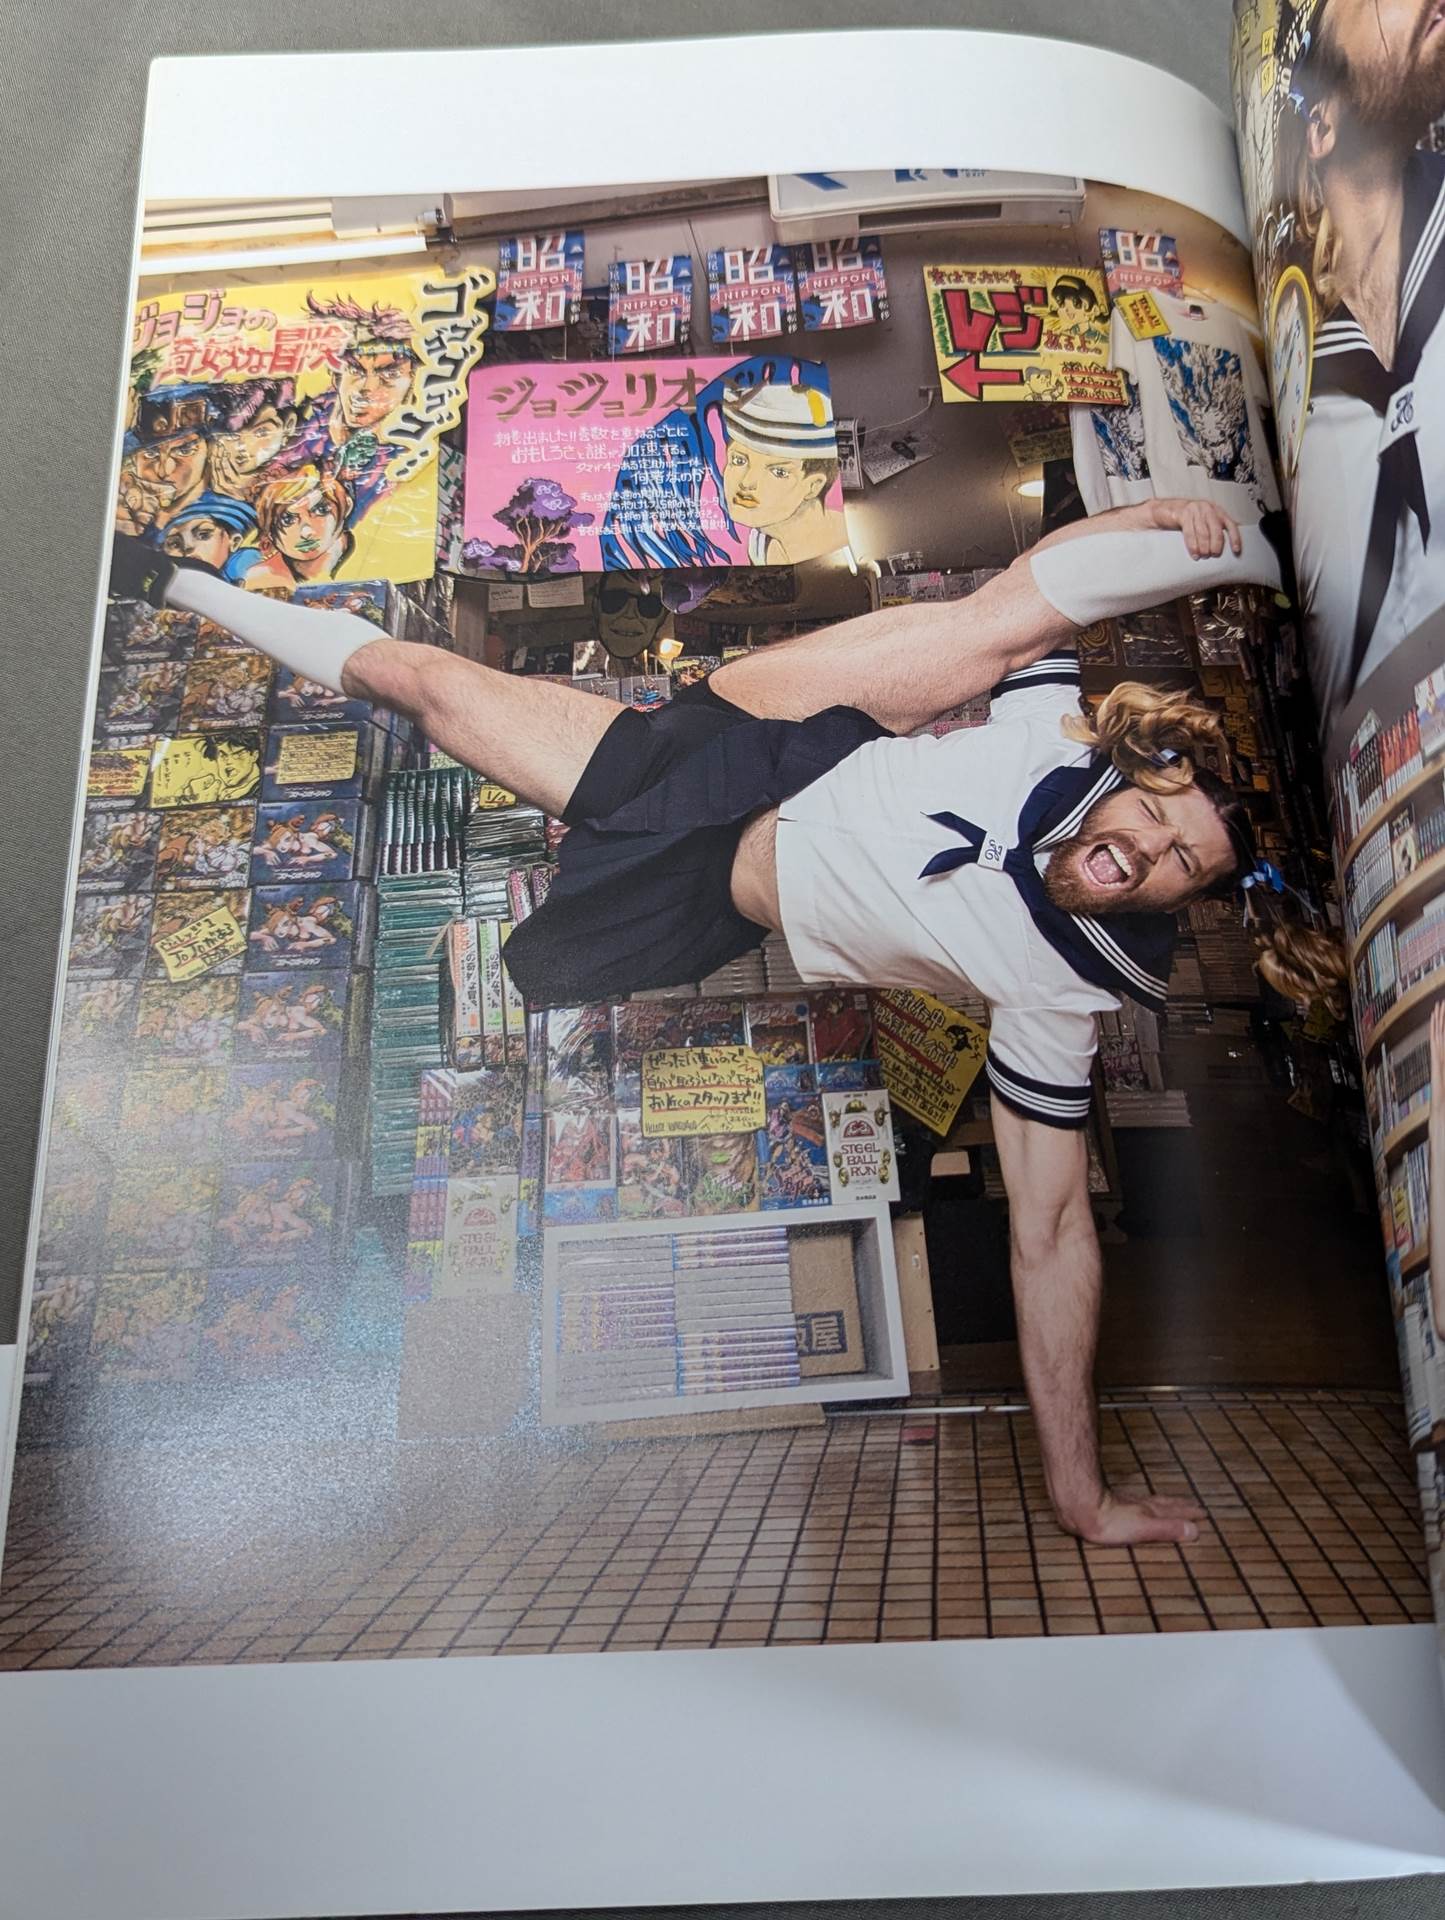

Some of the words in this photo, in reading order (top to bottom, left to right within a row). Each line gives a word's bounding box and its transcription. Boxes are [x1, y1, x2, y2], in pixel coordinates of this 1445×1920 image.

[512, 274, 570, 289] NIPPON
[812, 273, 872, 288] NIPPON
[723, 286, 781, 300] NIPPON
[623, 297, 679, 312] NIPPON
[941, 286, 1048, 352] レジ
[155, 324, 343, 380] 奇妙な冒険
[841, 1143, 880, 1155] STEEL
[847, 1154, 878, 1166] BALL
[850, 1166, 877, 1177] RUN
